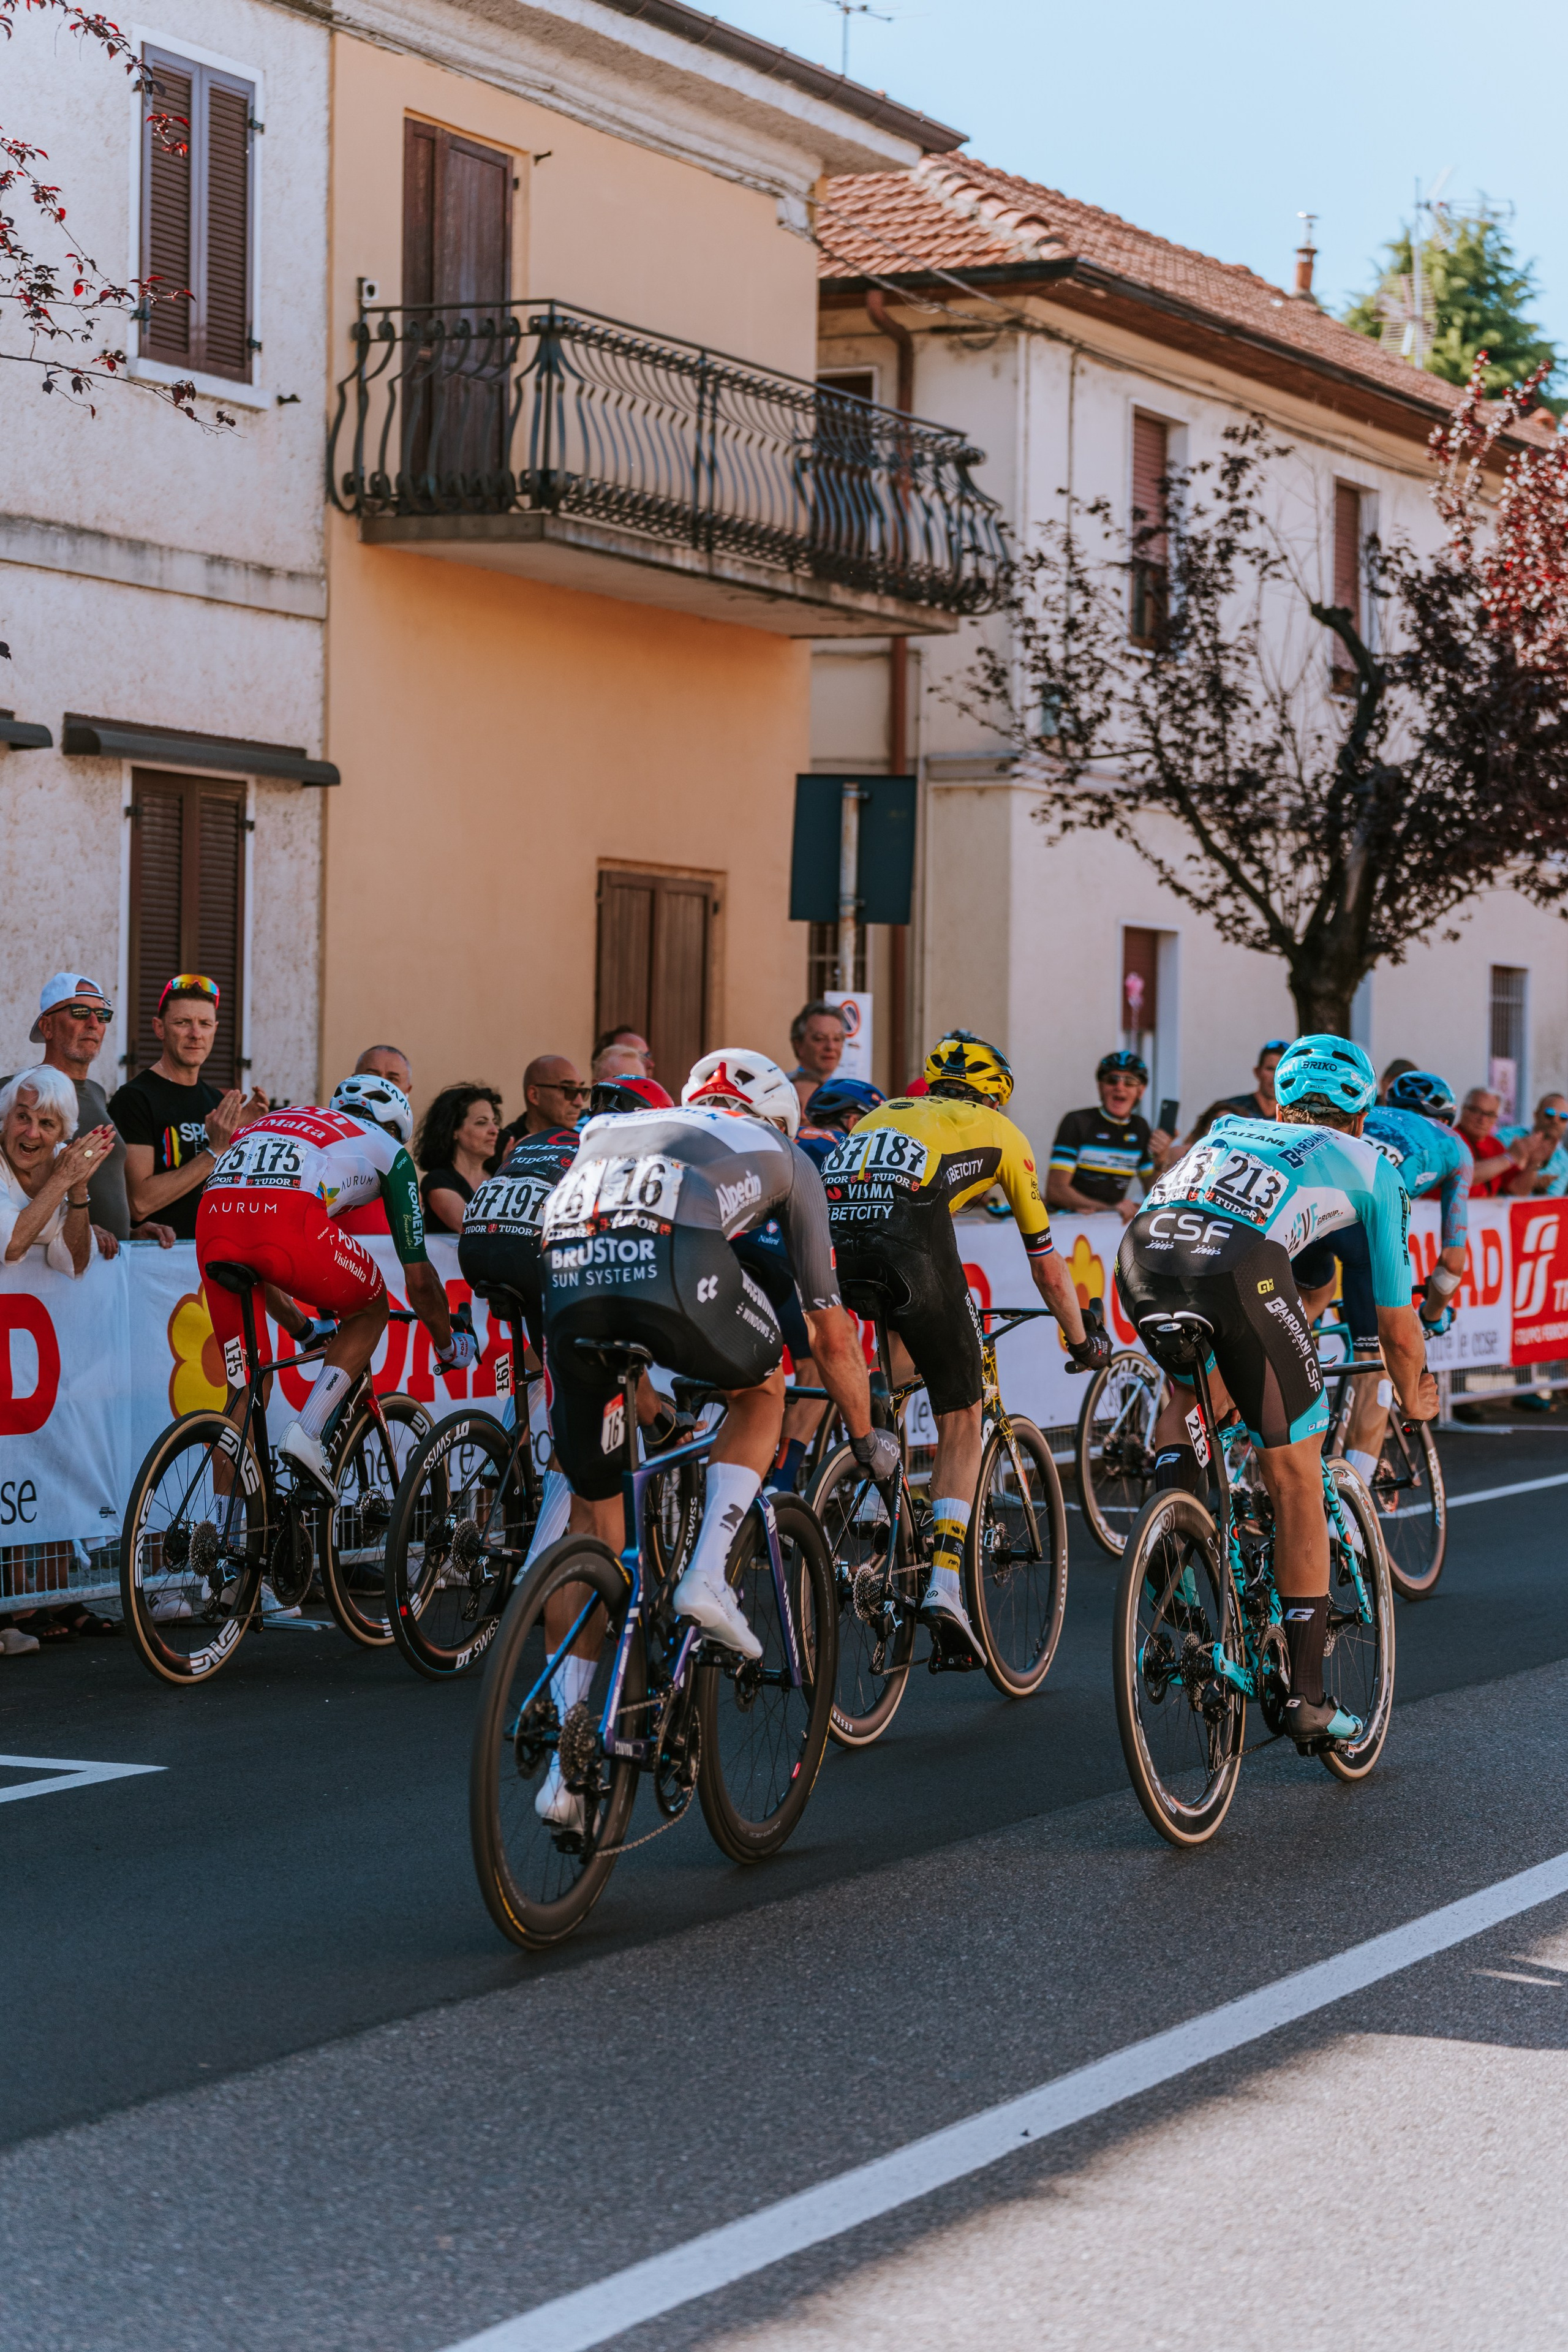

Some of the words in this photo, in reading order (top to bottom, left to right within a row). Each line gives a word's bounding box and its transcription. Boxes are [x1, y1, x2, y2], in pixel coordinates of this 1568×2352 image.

[1301, 1061, 1337, 1071] BRIKO
[179, 1122, 209, 1142] SPA
[1219, 1131, 1286, 1147] FAIZANE
[252, 1142, 301, 1173] 175
[509, 1155, 559, 1164] TUDOR
[827, 1136, 869, 1171] 87
[869, 1132, 925, 1172] 187
[254, 1178, 292, 1186] TUDOR
[341, 1175, 374, 1193] AURUM
[615, 1163, 666, 1208] 16
[848, 1183, 894, 1199] VISMA
[873, 1172, 910, 1188] TUDOR
[1214, 1155, 1281, 1210] 213
[209, 1202, 277, 1215] AURUM
[497, 1185, 551, 1223] 197
[715, 1170, 762, 1222] Alpecin
[1216, 1195, 1257, 1222] TUDOR
[407, 1181, 424, 1247] KOMETA
[831, 1205, 894, 1221] BETCITY
[1317, 1210, 1340, 1226] GROUP
[499, 1225, 533, 1237] TUDOR
[1036, 1232, 1052, 1244] SR
[1149, 1213, 1234, 1243] CSF
[552, 1236, 657, 1270] BRUSTOR
[1145, 1242, 1174, 1251] SMP
[1190, 1246, 1222, 1256] SMP
[334, 1250, 367, 1284] VisitMalta
[552, 1271, 579, 1288] SUN
[585, 1263, 658, 1286] SYSTEMS
[742, 1307, 771, 1338] WINDOWS
[1273, 1312, 1304, 1359] VALVOLE
[1264, 1296, 1312, 1356] BARDIANI
[1305, 1357, 1321, 1392] CSF
[225, 1341, 243, 1378] 175
[326, 1373, 339, 1391] GSPORT
[496, 1358, 510, 1391] 197
[453, 1420, 470, 1443] DT
[606, 1411, 620, 1452] 16
[1188, 1415, 1207, 1462] 213
[685, 1497, 698, 1549] SWISS
[455, 1648, 473, 1670] DT
[473, 1618, 500, 1659] SWISS
[832, 1708, 853, 1734] RESER
